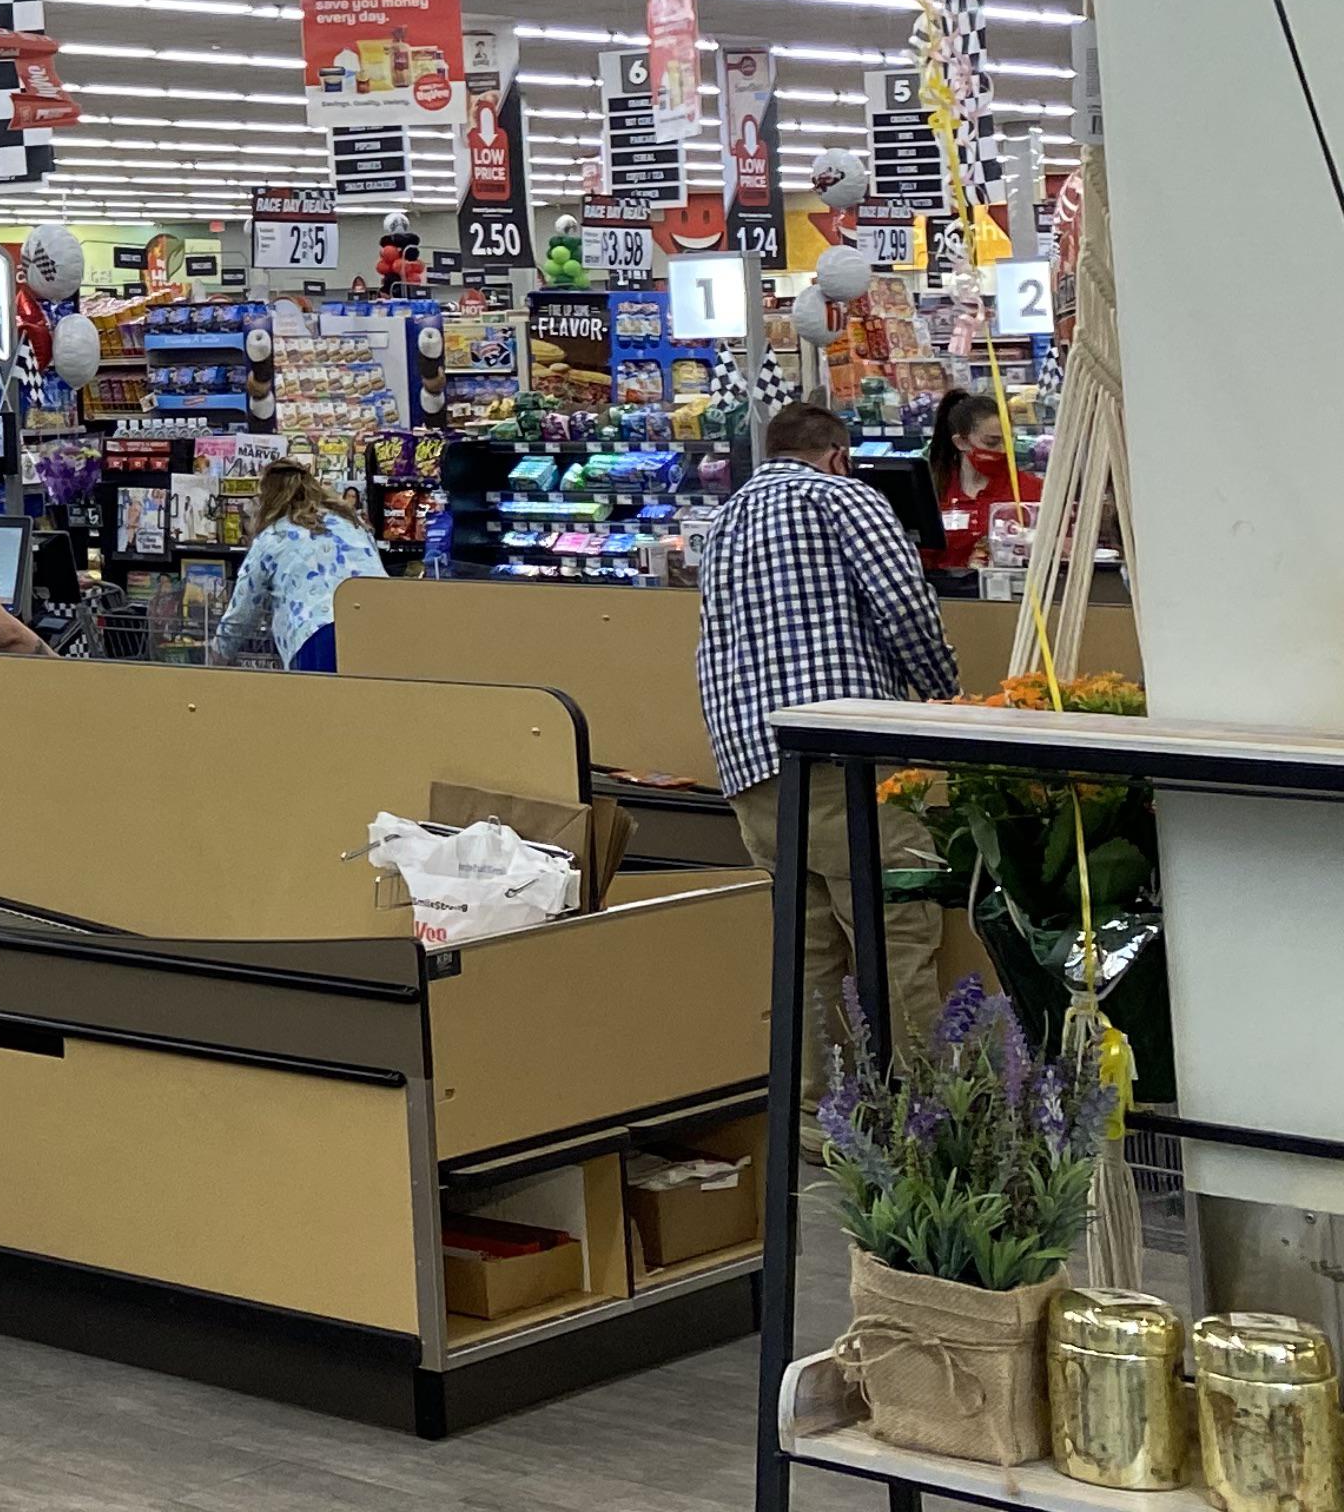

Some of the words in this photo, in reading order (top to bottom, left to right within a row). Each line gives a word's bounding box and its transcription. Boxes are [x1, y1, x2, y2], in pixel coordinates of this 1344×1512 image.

[315, 0, 350, 10] save
[352, 0, 379, 13] you
[316, 12, 356, 26] every
[359, 11, 390, 25] day.
[628, 59, 648, 85] 6
[893, 79, 911, 103] 5
[473, 148, 505, 165] LOW
[739, 158, 765, 173] LOW
[473, 166, 506, 181] PRICE
[739, 175, 767, 187] PRICE
[469, 222, 521, 256] 2.50
[695, 277, 716, 320] 1
[1017, 278, 1048, 318] 2
[538, 317, 603, 341] FLAVOR
